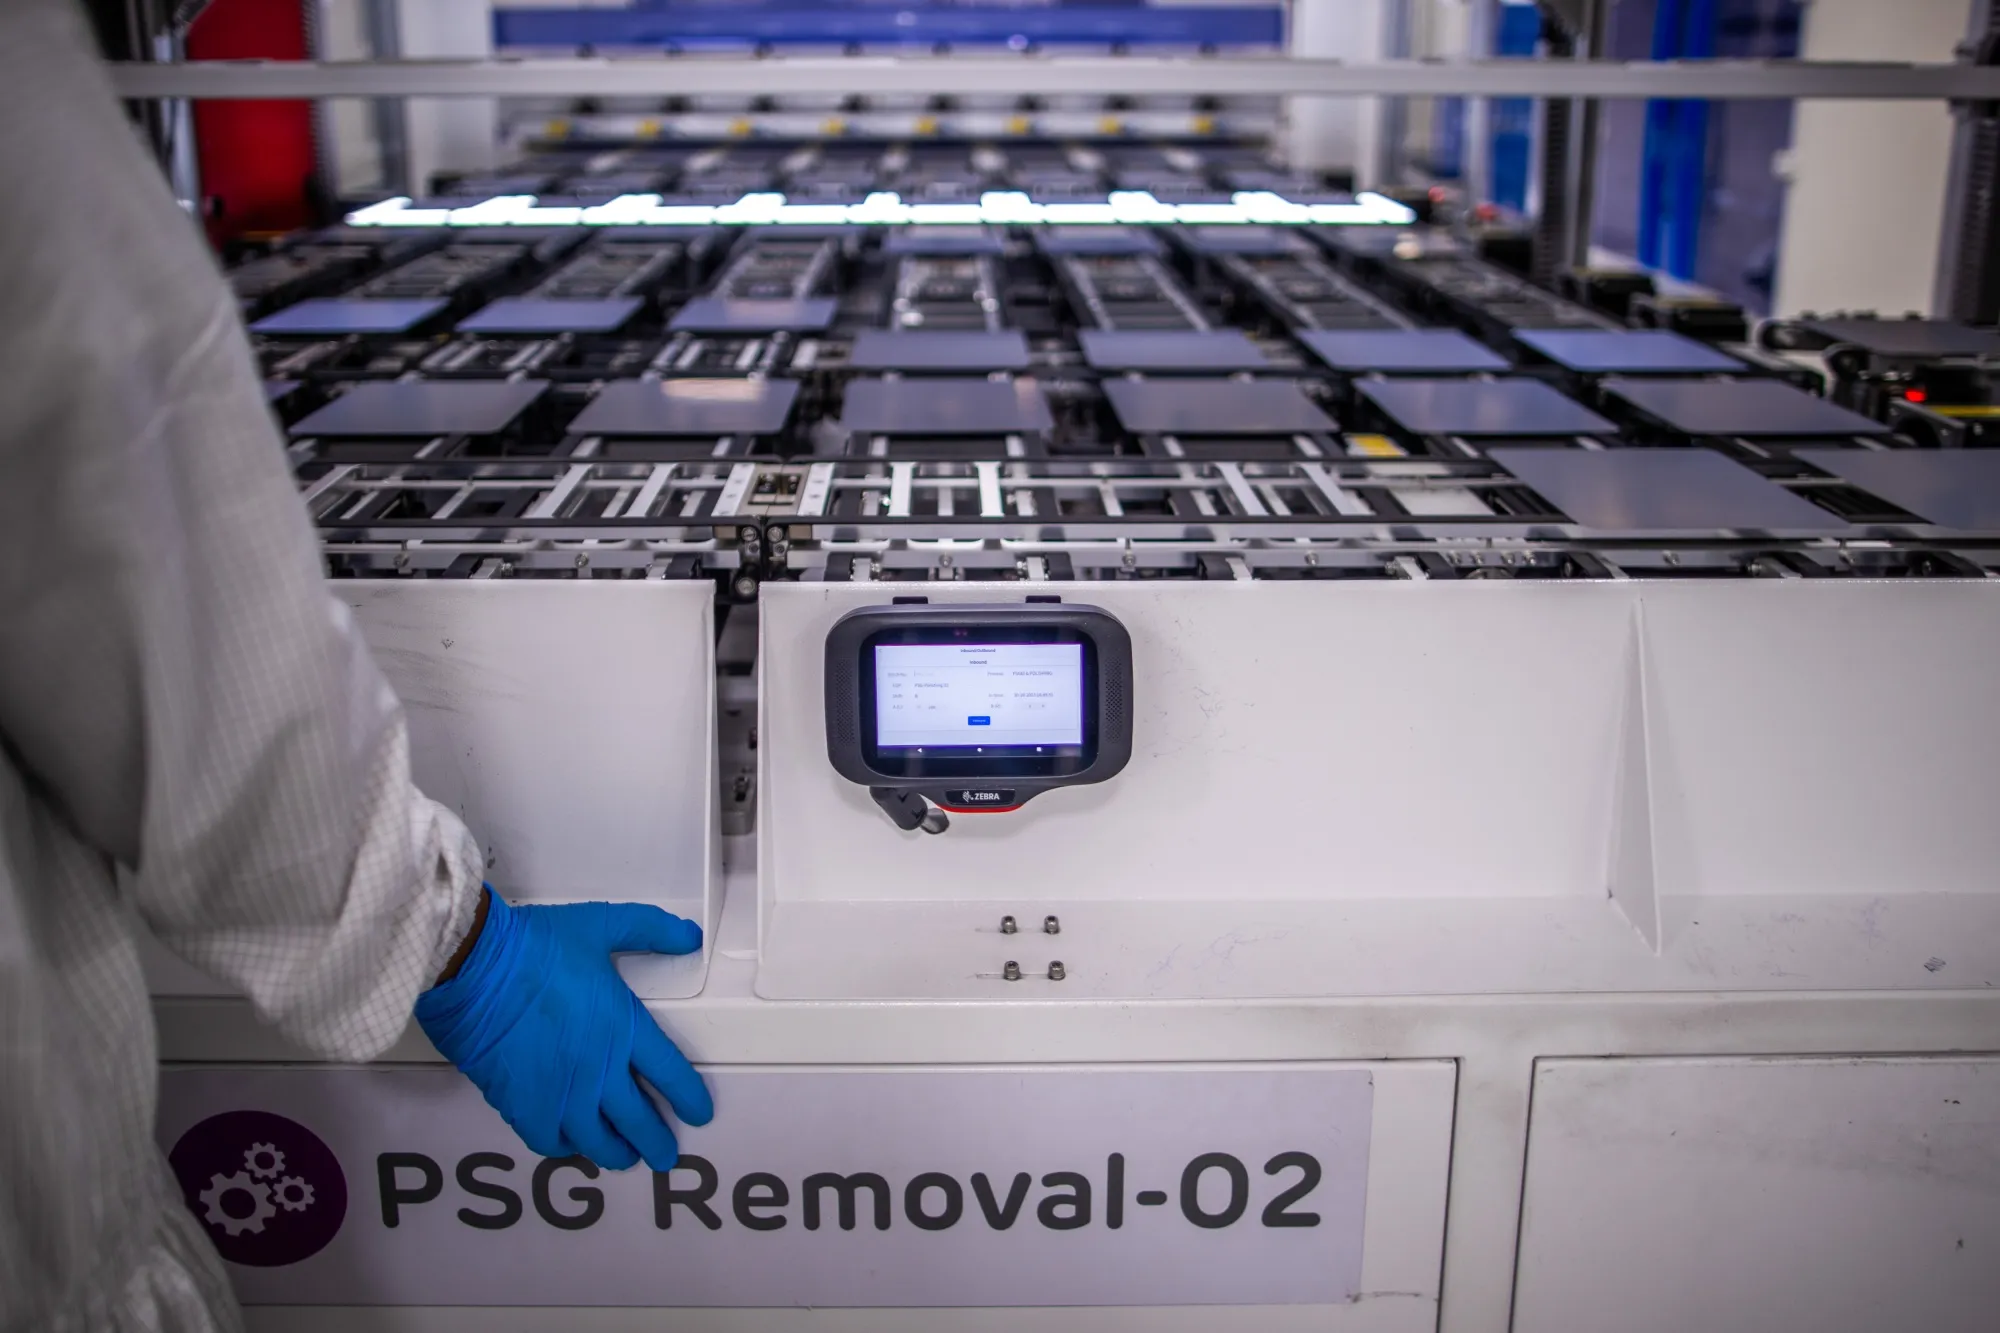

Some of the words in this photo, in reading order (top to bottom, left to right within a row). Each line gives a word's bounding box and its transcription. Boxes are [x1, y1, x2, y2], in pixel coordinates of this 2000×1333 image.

[974, 792, 1000, 800] ZEBRA
[377, 1152, 605, 1230] PSG
[652, 1151, 1322, 1231] Removal-02
